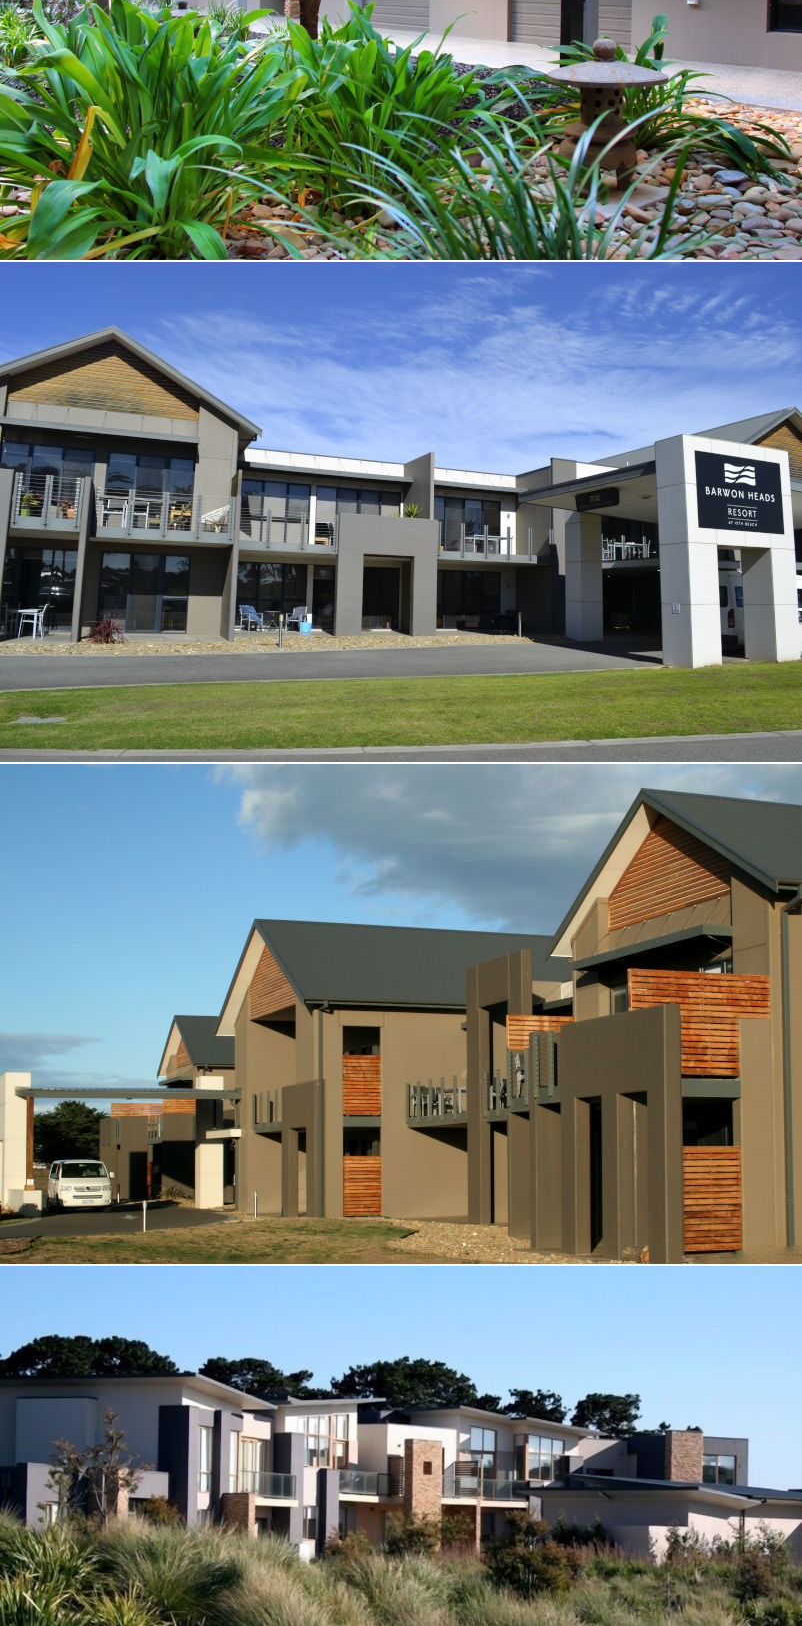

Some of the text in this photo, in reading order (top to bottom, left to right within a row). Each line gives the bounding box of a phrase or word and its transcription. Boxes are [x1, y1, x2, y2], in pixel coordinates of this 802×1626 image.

[705, 486, 776, 503] BARWON HEADS
[727, 507, 757, 518] RESORT
